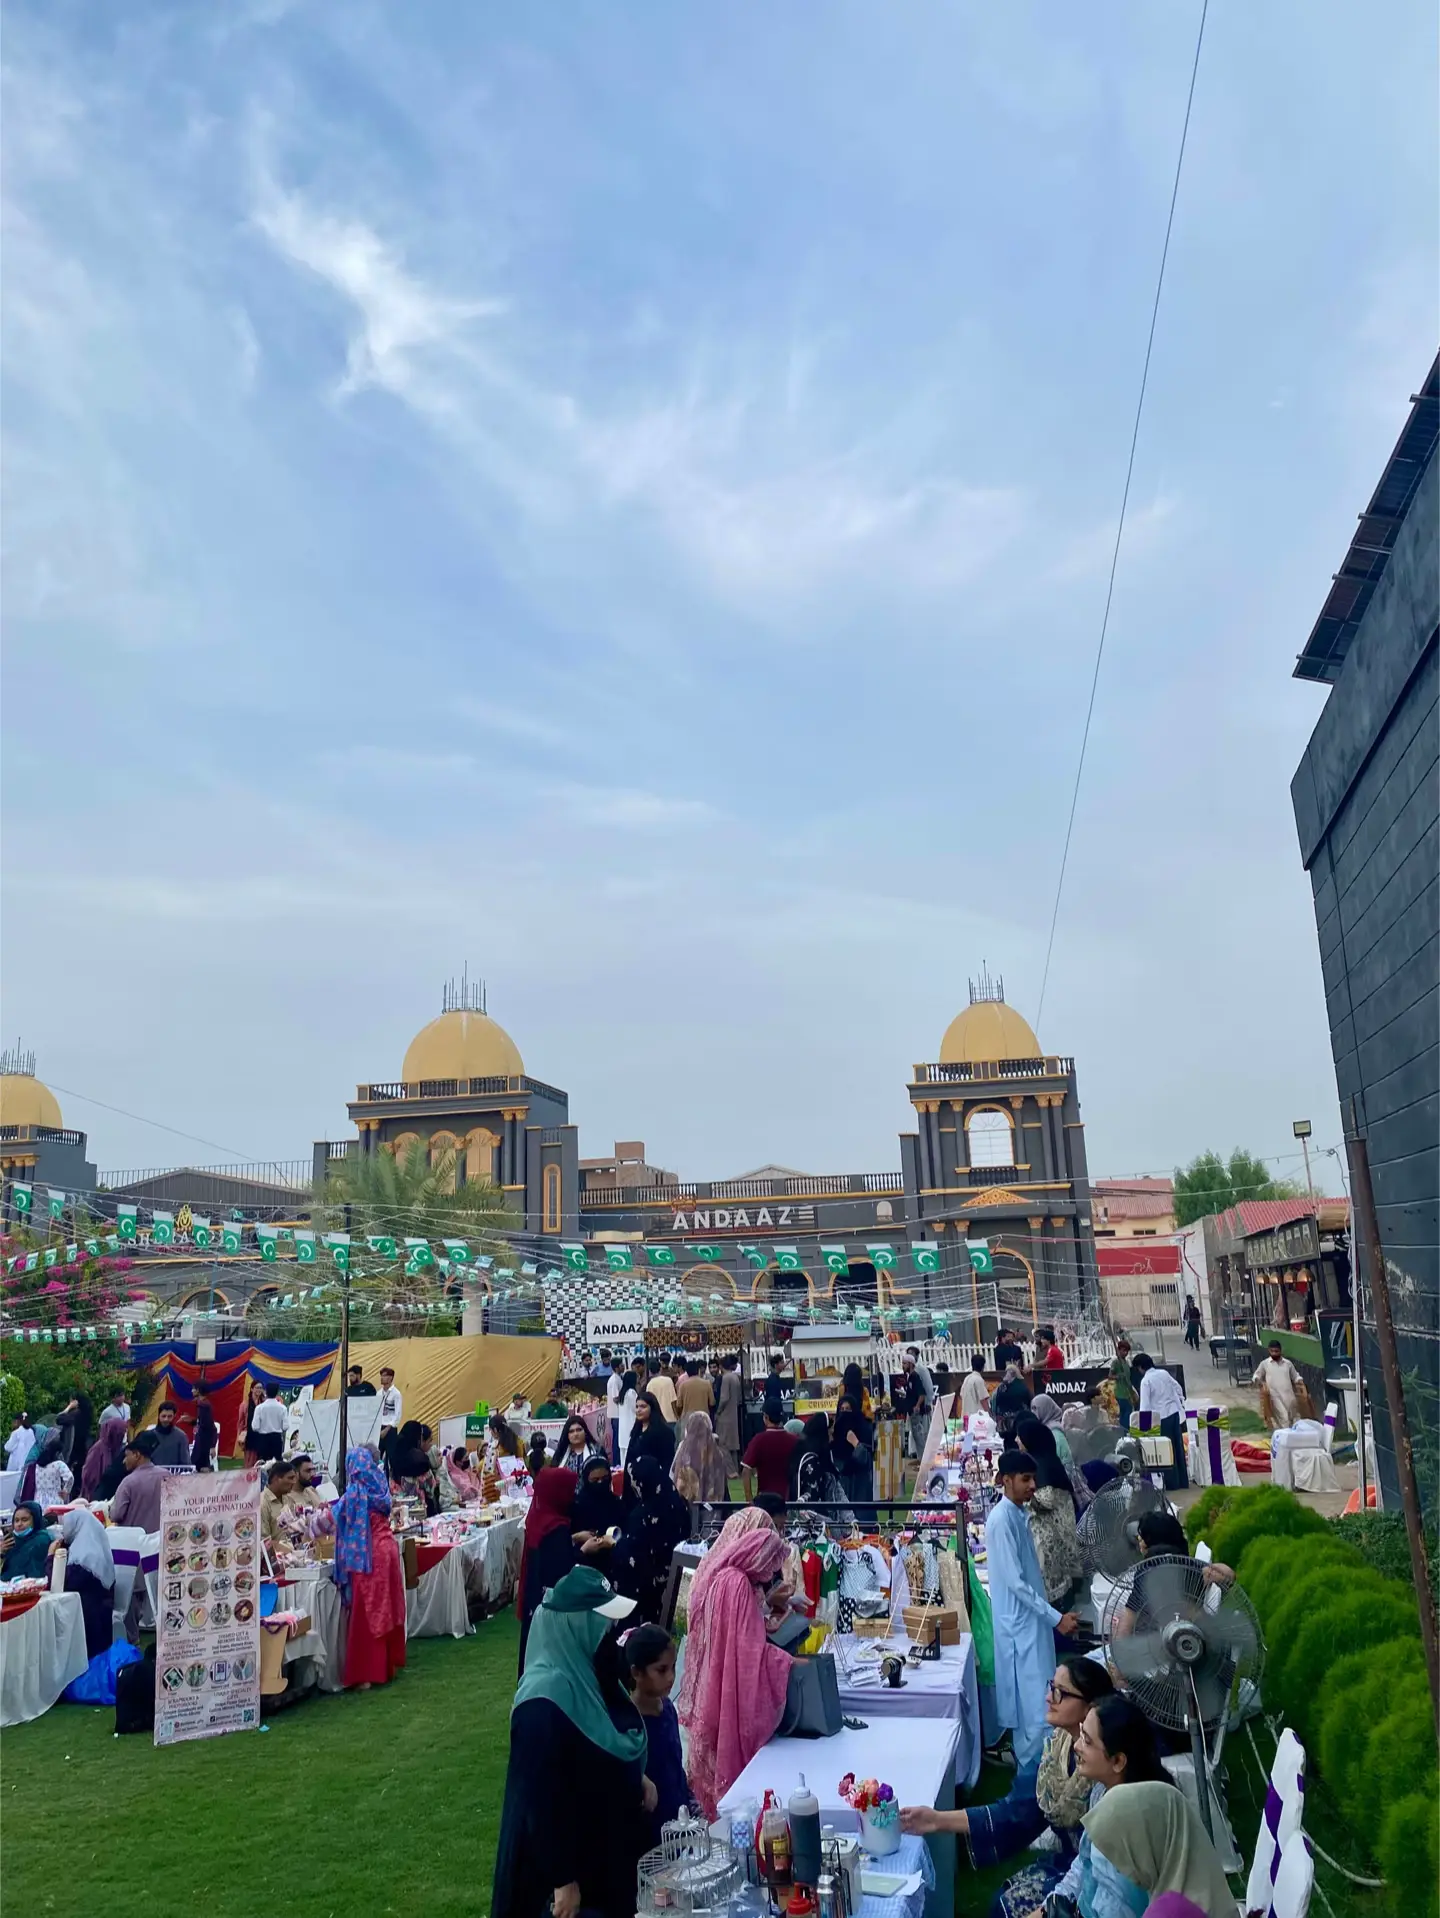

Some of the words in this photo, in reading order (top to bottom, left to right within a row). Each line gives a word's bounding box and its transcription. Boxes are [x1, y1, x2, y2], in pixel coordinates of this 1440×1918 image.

[672, 1206, 792, 1231] ANDAAZ
[593, 1323, 644, 1336] ANDAAZ
[1045, 1381, 1087, 1394] ANDAAZ
[184, 1497, 205, 1506] YOUR
[206, 1493, 239, 1504] PREMIER
[169, 1506, 201, 1517] GIFTING
[202, 1501, 254, 1514] DESTINATION
